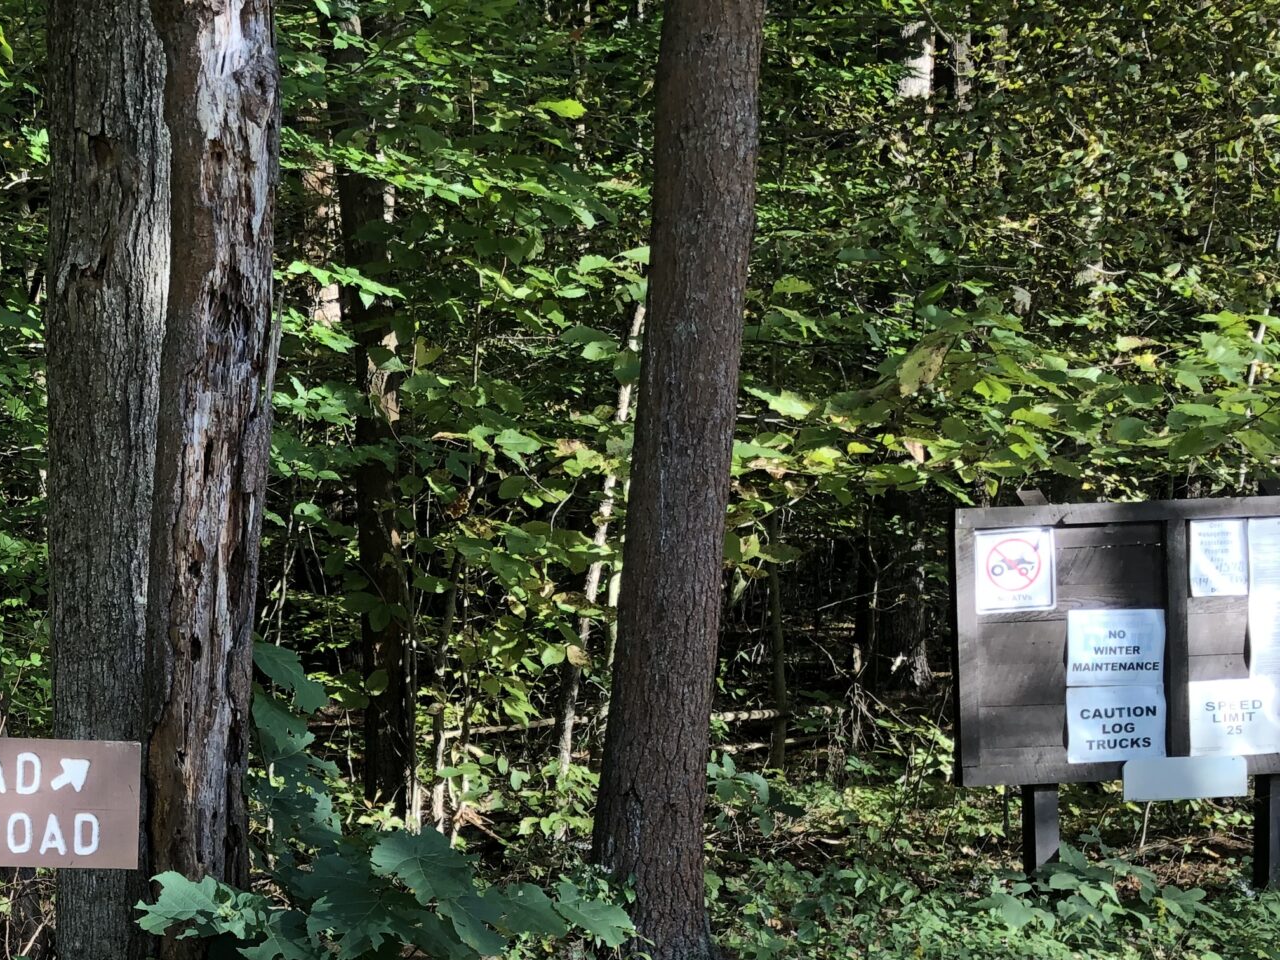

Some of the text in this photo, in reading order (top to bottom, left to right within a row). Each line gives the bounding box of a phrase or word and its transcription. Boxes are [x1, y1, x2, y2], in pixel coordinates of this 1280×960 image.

[1108, 630, 1127, 640] NO
[1093, 645, 1141, 656] WINTER
[1072, 661, 1160, 672] MAINTENANCE
[1205, 699, 1263, 712] SPEED
[1080, 705, 1157, 720] CAUTION
[1212, 711, 1256, 724] LIMIT
[1102, 722, 1135, 735] LOG
[1227, 725, 1243, 736] 25
[1086, 737, 1151, 751] TRUCKS
